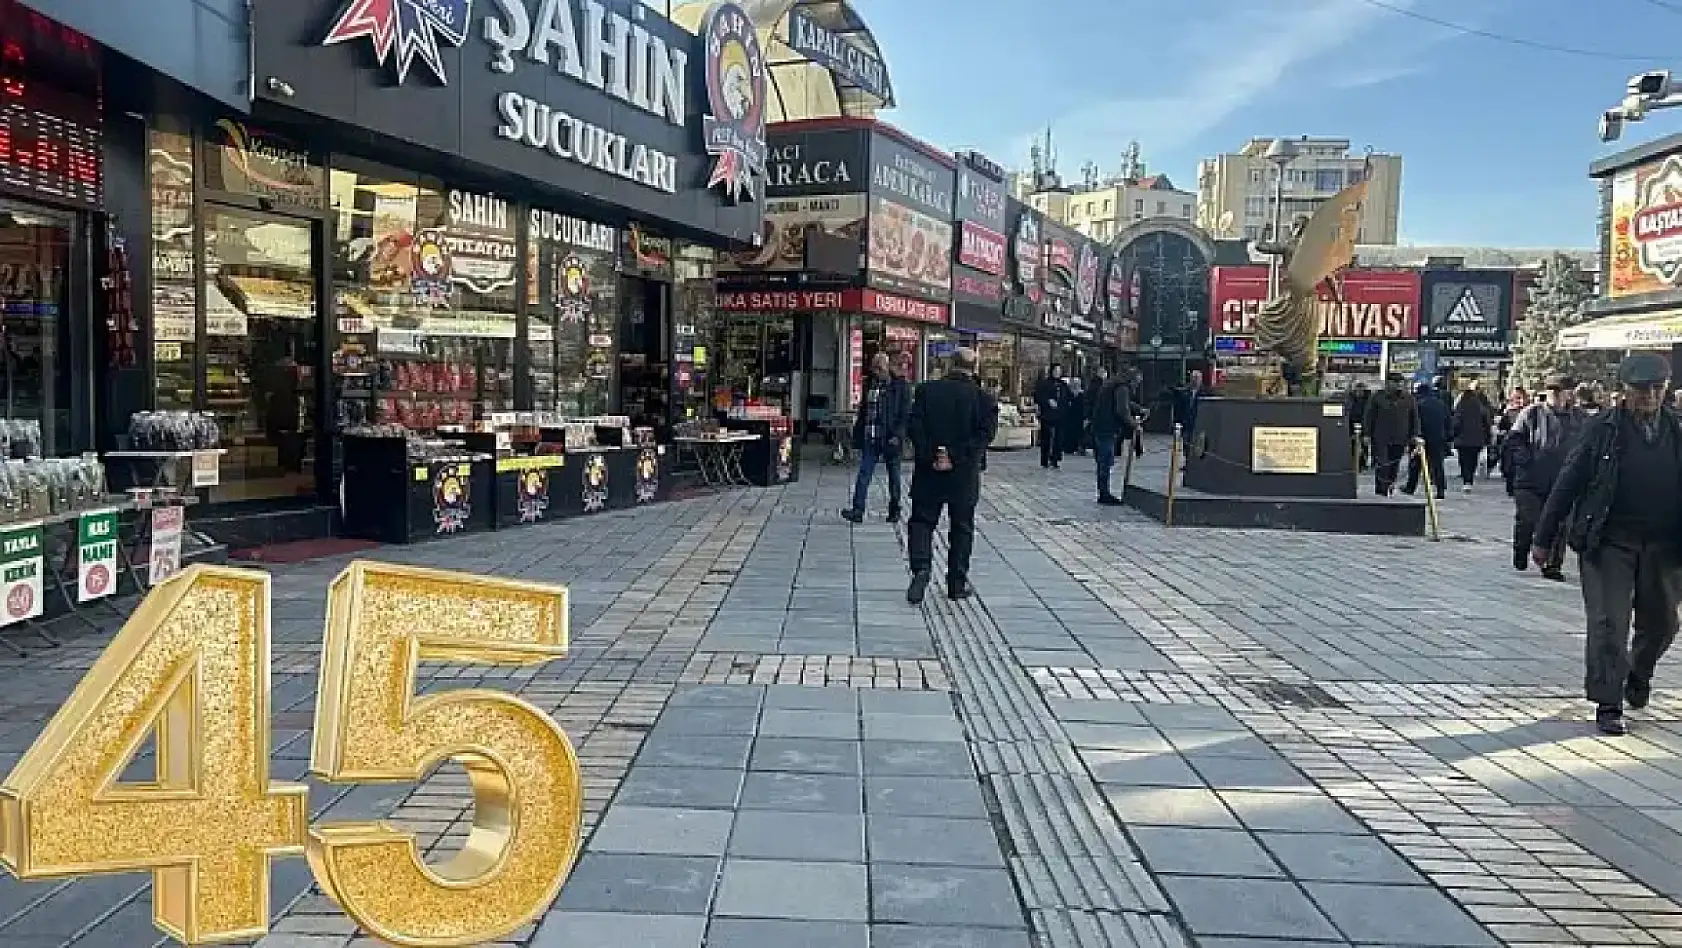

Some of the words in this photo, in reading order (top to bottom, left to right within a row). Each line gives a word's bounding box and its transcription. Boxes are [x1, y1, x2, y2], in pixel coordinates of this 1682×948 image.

[484, 0, 689, 127] ŞAHİN
[498, 92, 678, 193] SUCUKLARI
[449, 190, 507, 229] ŞAHİN
[530, 208, 615, 252] SUCUKLARI
